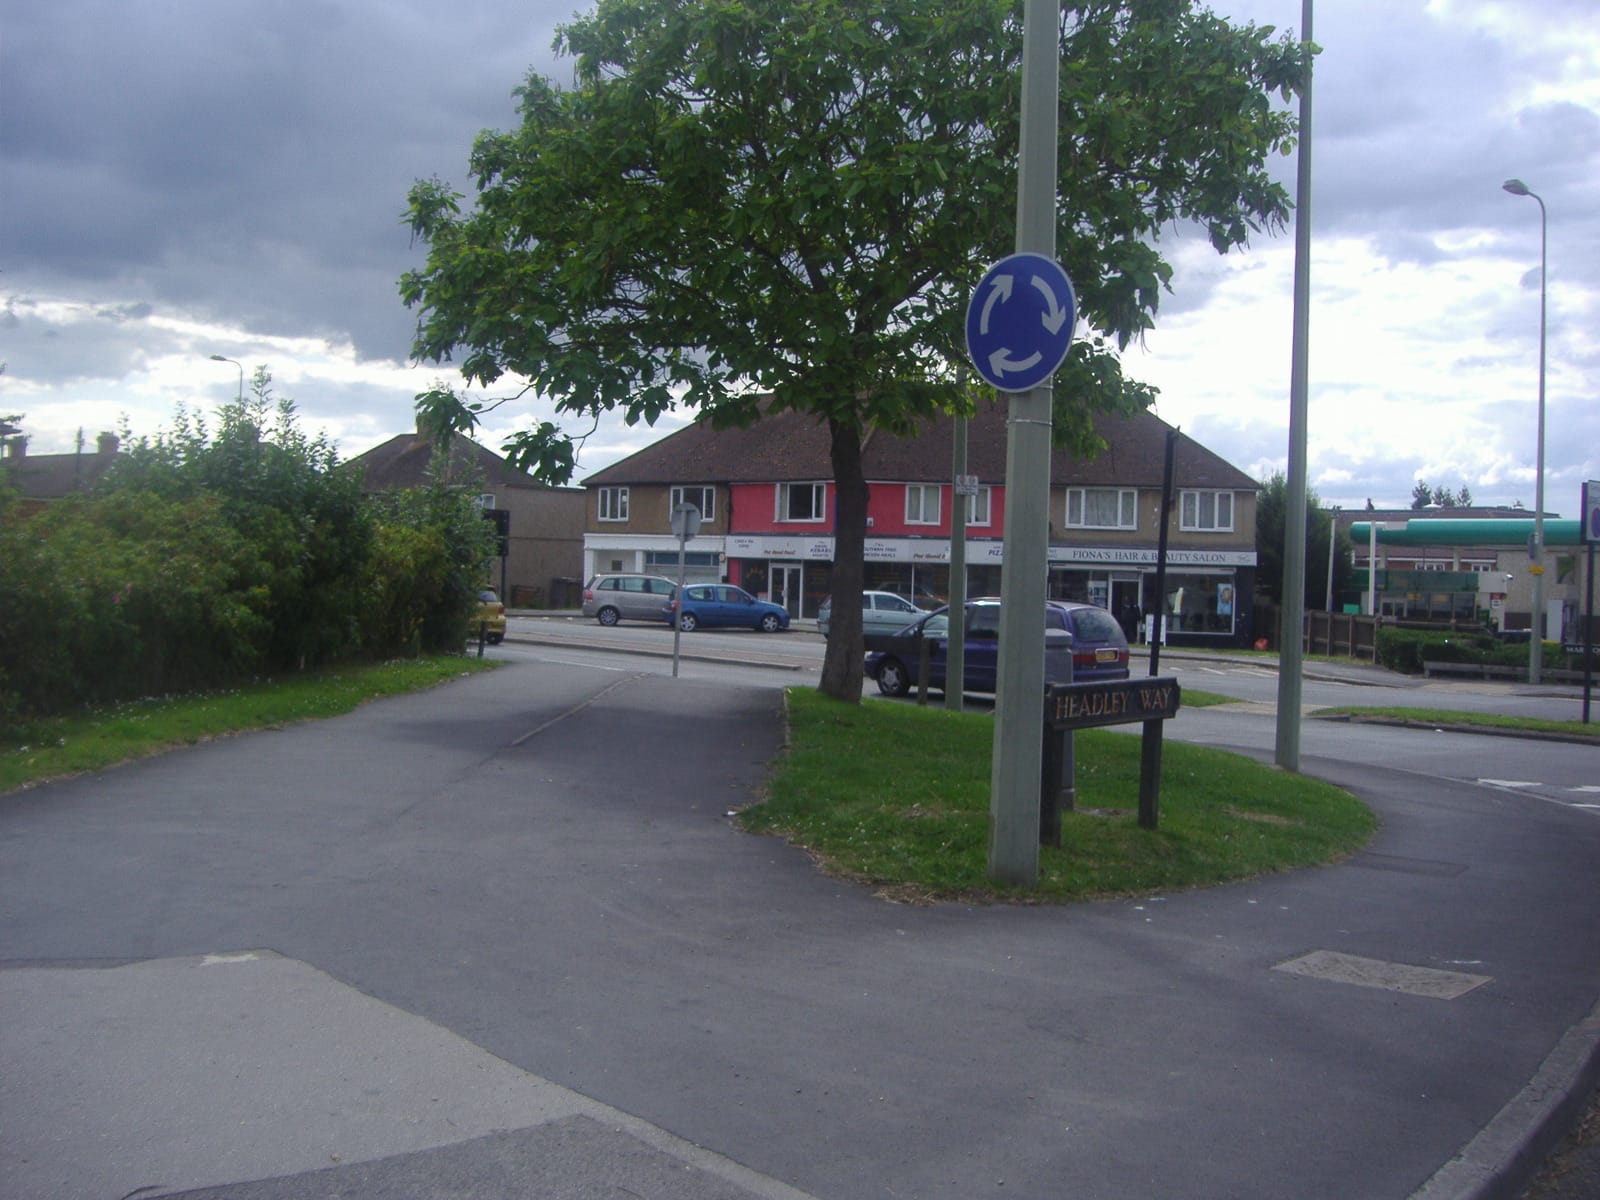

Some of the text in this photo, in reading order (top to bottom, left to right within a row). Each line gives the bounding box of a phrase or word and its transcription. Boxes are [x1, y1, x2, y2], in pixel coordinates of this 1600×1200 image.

[1072, 551, 1111, 560] FIONA'S
[1115, 552, 1139, 560] HAIR
[1151, 553, 1191, 561] BAUTY
[1192, 554, 1226, 562] SALON
[1056, 688, 1172, 719] HEADLEY WAY
